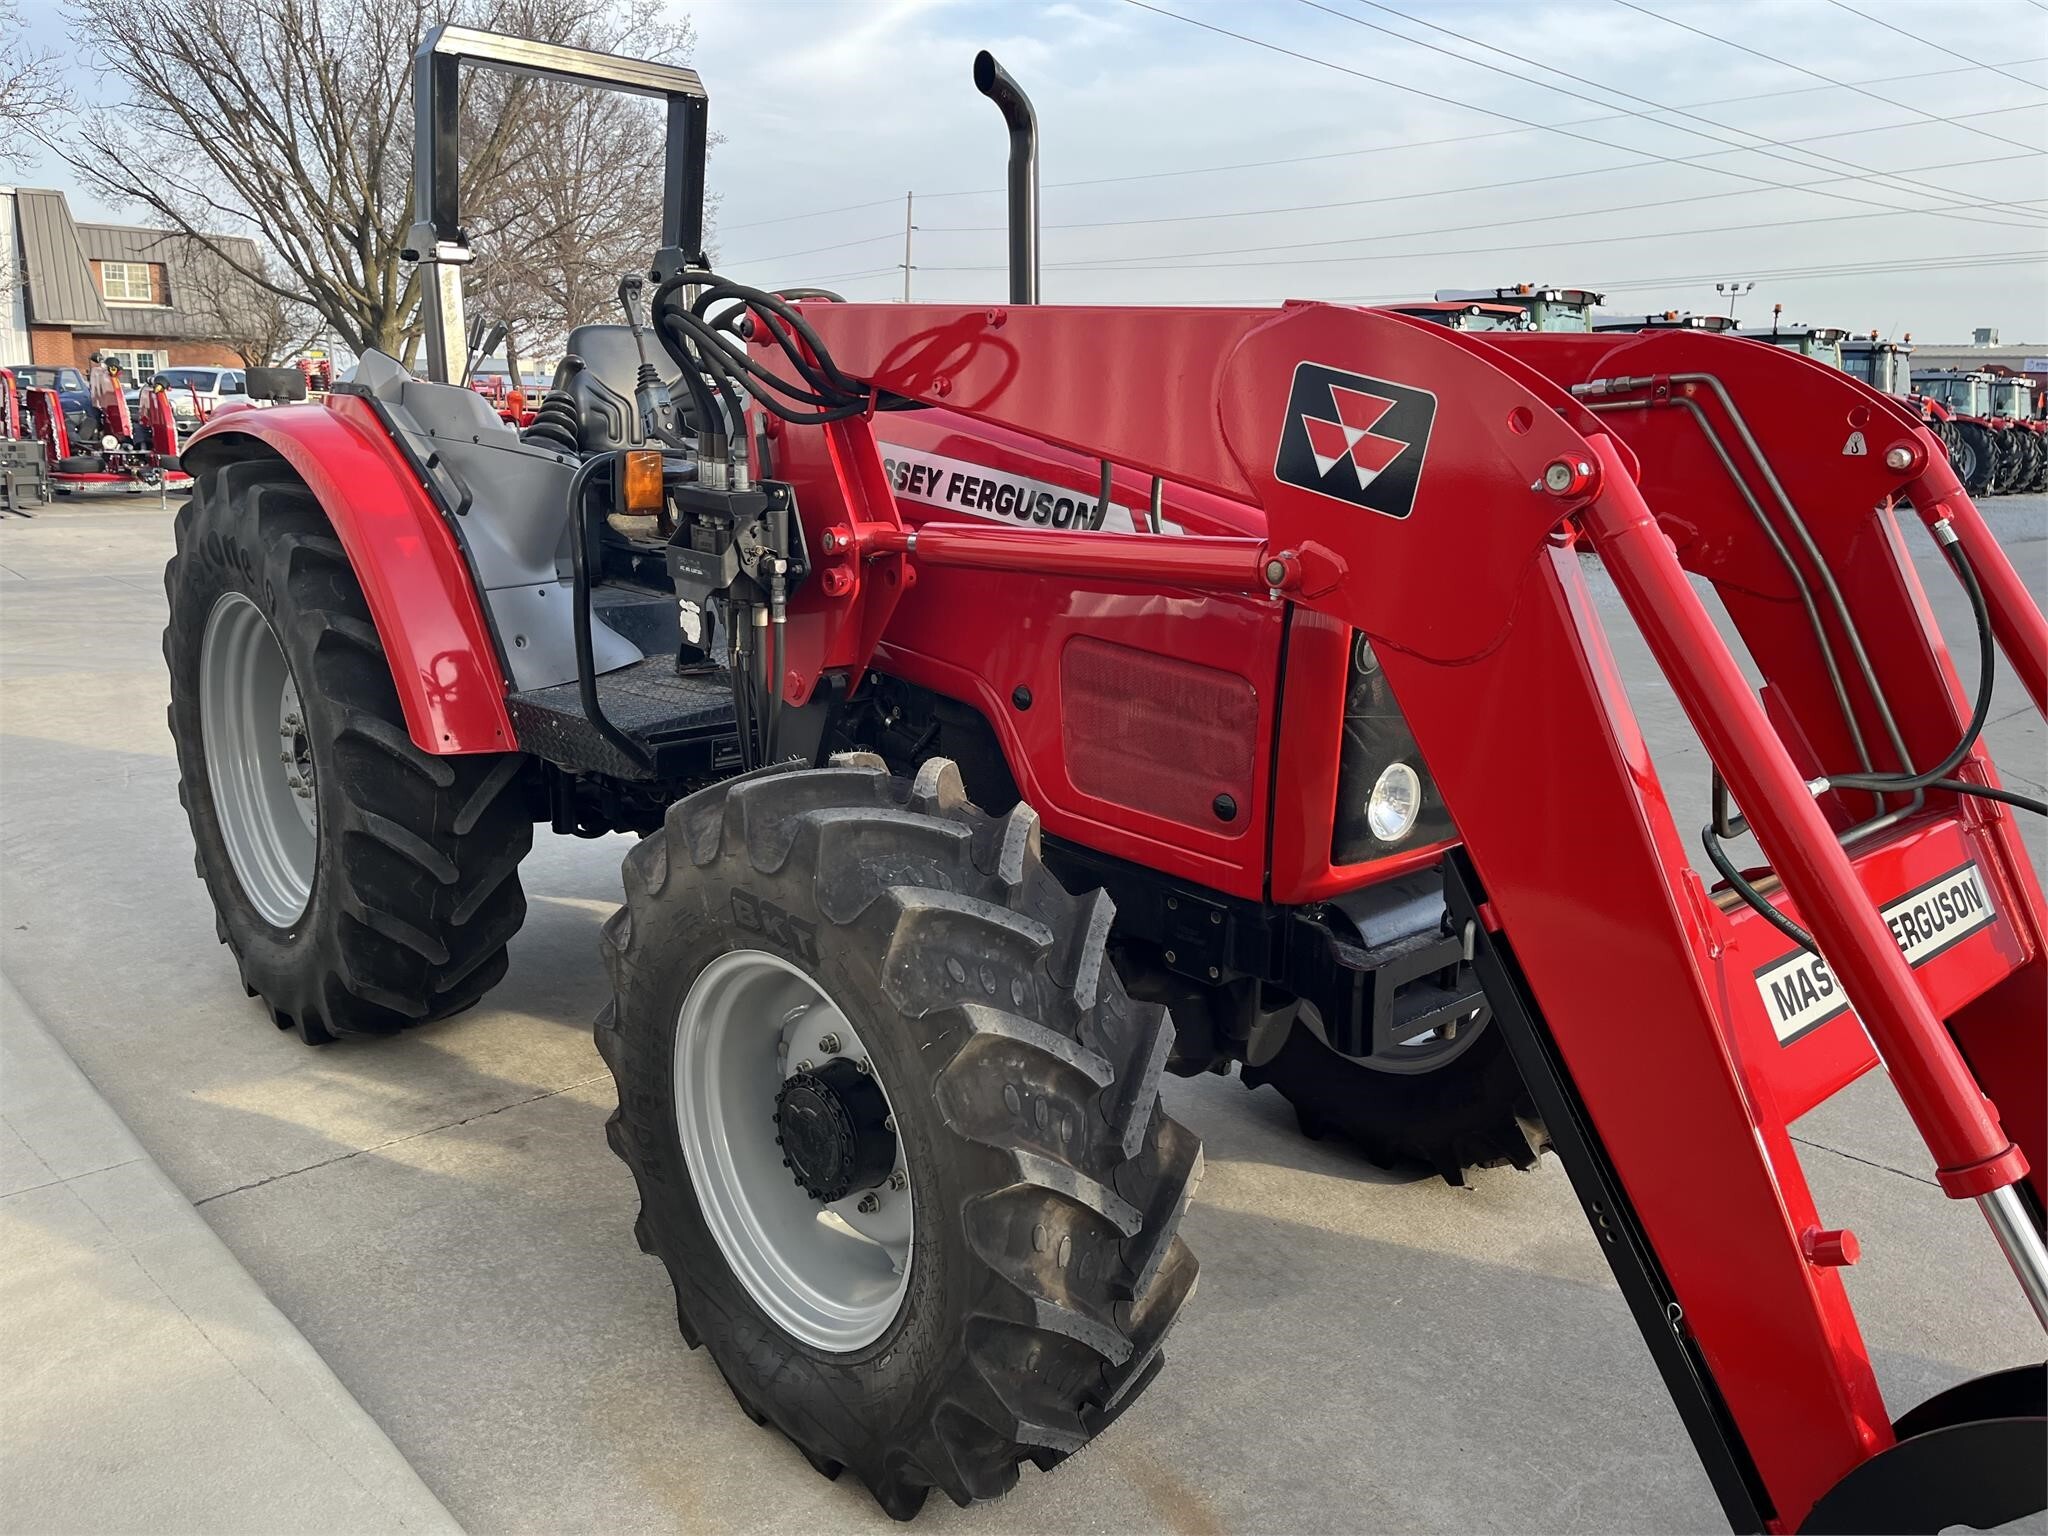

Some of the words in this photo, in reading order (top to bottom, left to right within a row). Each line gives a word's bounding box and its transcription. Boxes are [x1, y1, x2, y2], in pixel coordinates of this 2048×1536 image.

[883, 458, 944, 498] SSEY
[946, 473, 1101, 531] FERGUSON
[731, 886, 819, 966] BKT
[1770, 958, 1836, 1022] MAS
[1886, 877, 1983, 953] ERGUSON
